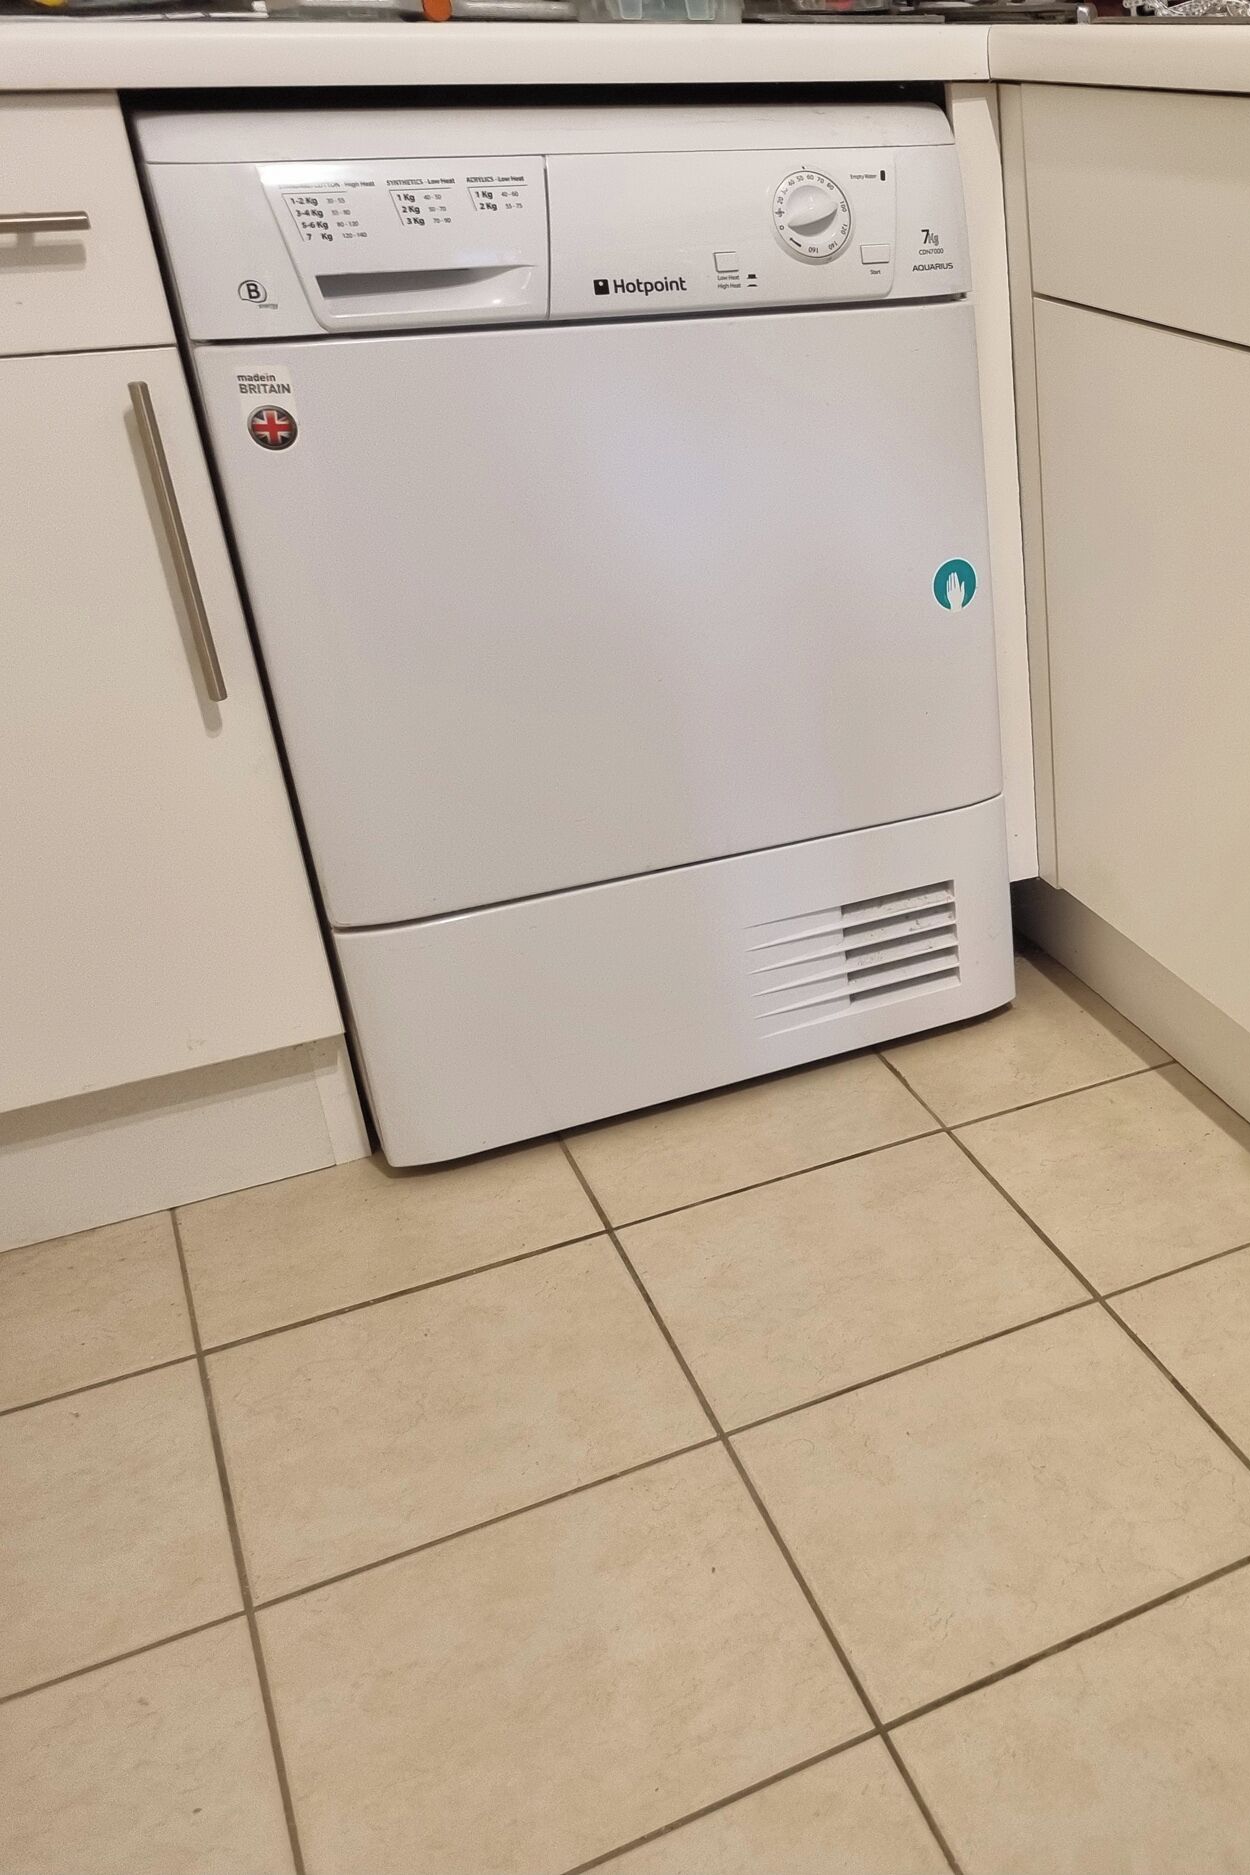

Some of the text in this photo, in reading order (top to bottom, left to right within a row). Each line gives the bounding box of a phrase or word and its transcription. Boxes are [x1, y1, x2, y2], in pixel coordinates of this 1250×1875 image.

[404, 194, 416, 203] Kg
[482, 191, 494, 200] Kg
[290, 197, 305, 205] 1-2
[305, 197, 319, 206] Kg
[408, 205, 421, 214] Kg
[486, 202, 498, 211] Kg
[839, 200, 847, 213] 100
[296, 209, 311, 217] 3-4
[311, 209, 324, 218] Kg
[316, 221, 329, 230] Kg
[413, 217, 426, 226] Kg
[306, 233, 312, 241] 7
[321, 233, 334, 242] Kg
[912, 262, 954, 272] AQUARIUS
[246, 283, 261, 299] B
[613, 277, 687, 296] Hotpoint
[239, 384, 291, 394] BRITAIN
